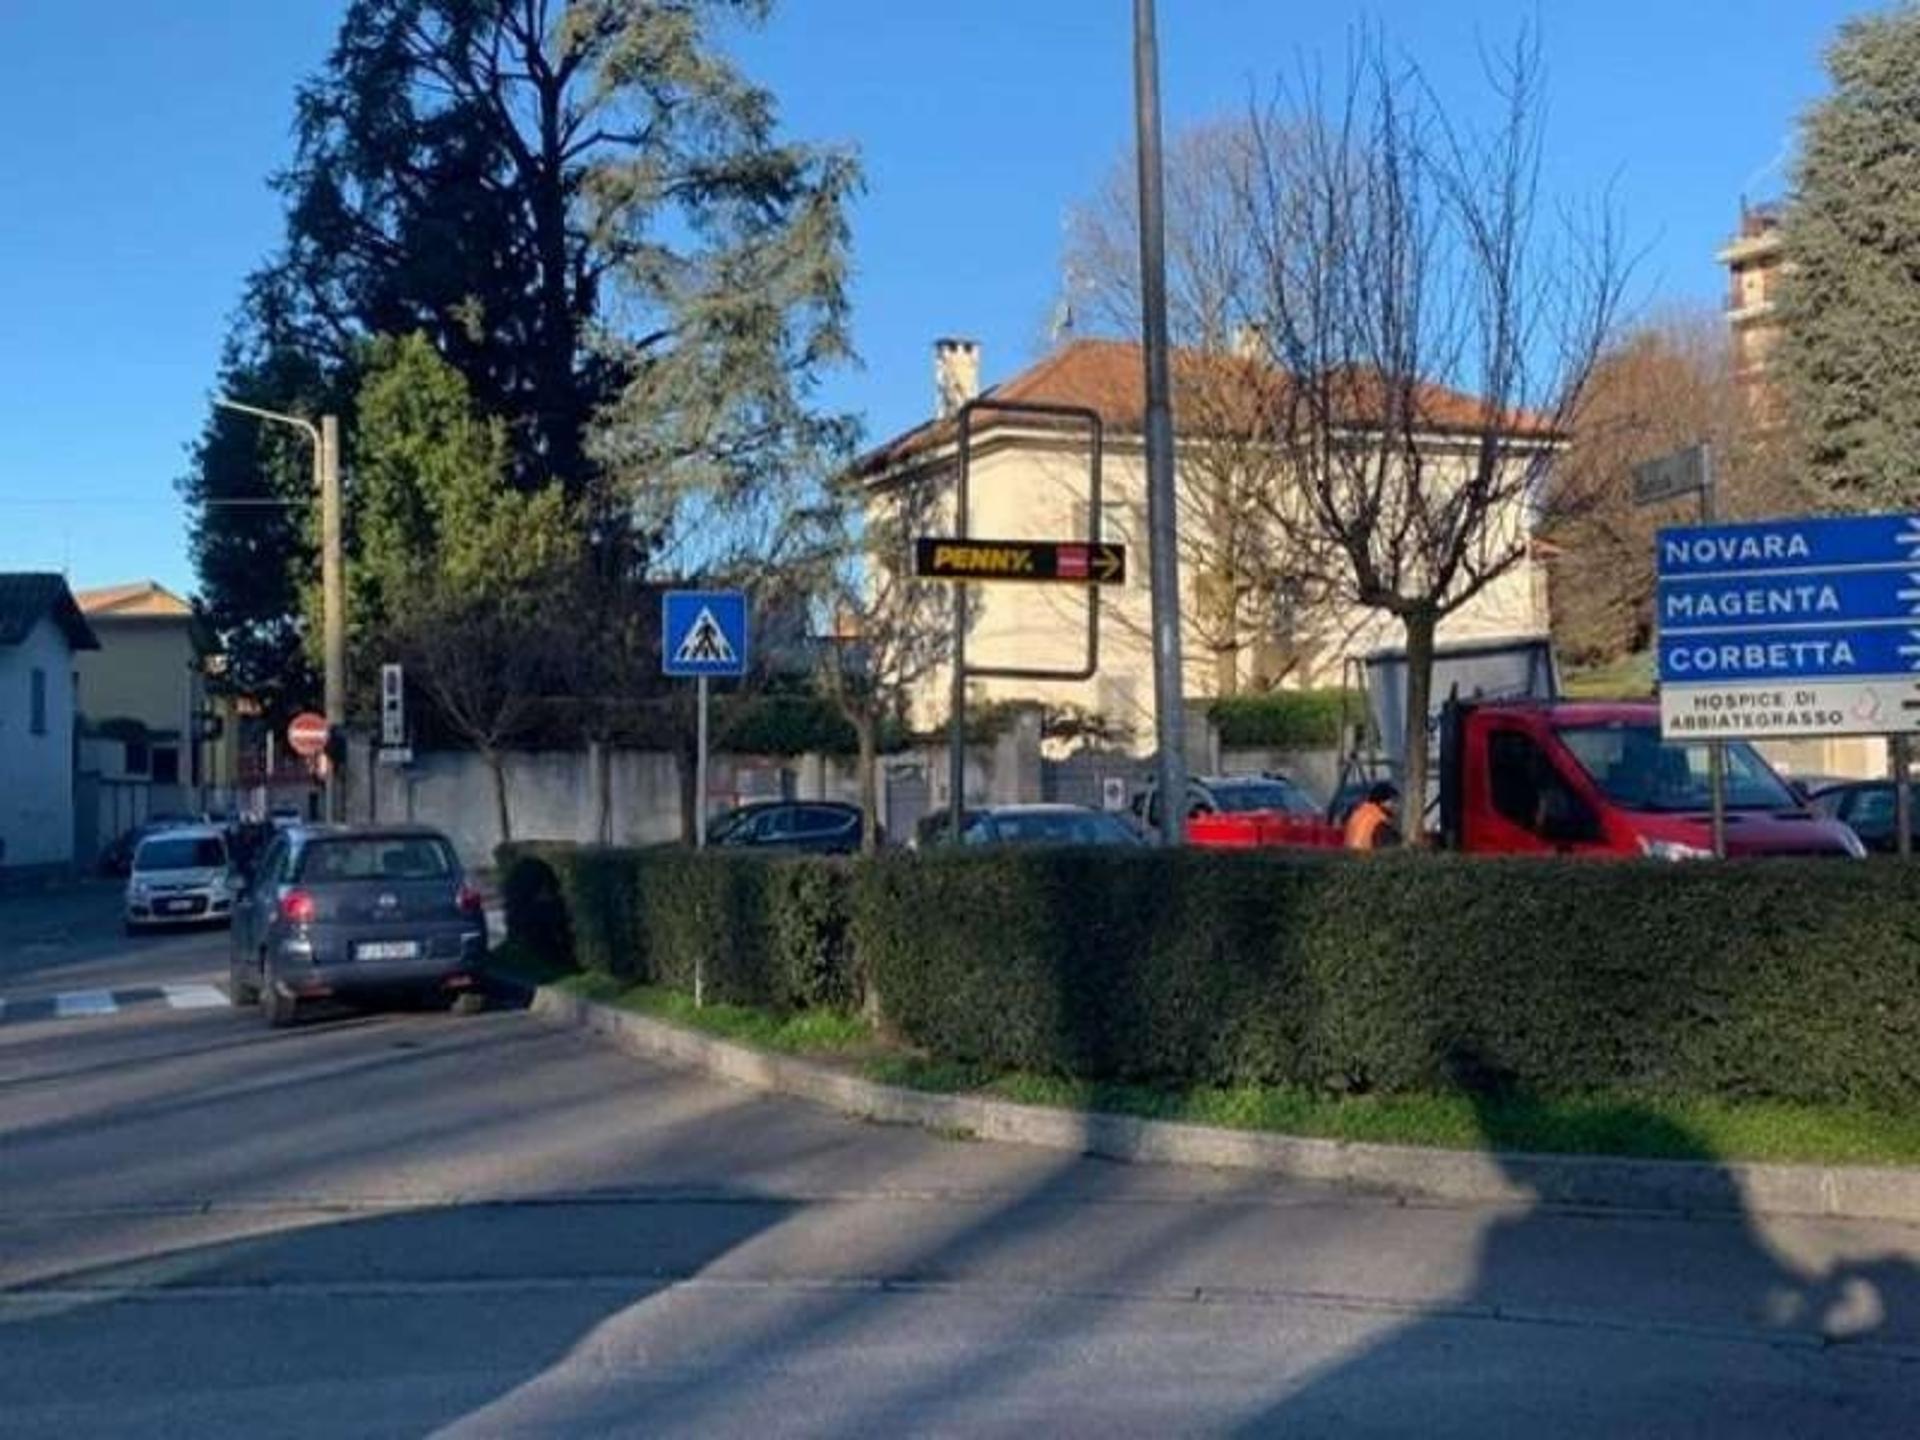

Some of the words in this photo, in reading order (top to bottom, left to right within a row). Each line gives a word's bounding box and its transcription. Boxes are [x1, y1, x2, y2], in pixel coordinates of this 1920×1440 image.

[1666, 533, 1810, 563] NOVARA
[1667, 586, 1840, 617] MAGENTA
[1668, 641, 1856, 671] CORBETTA
[1693, 691, 1784, 711] HOSPICE
[1795, 690, 1816, 707] DI
[1669, 709, 1844, 730] ABBIATEGRASSO
